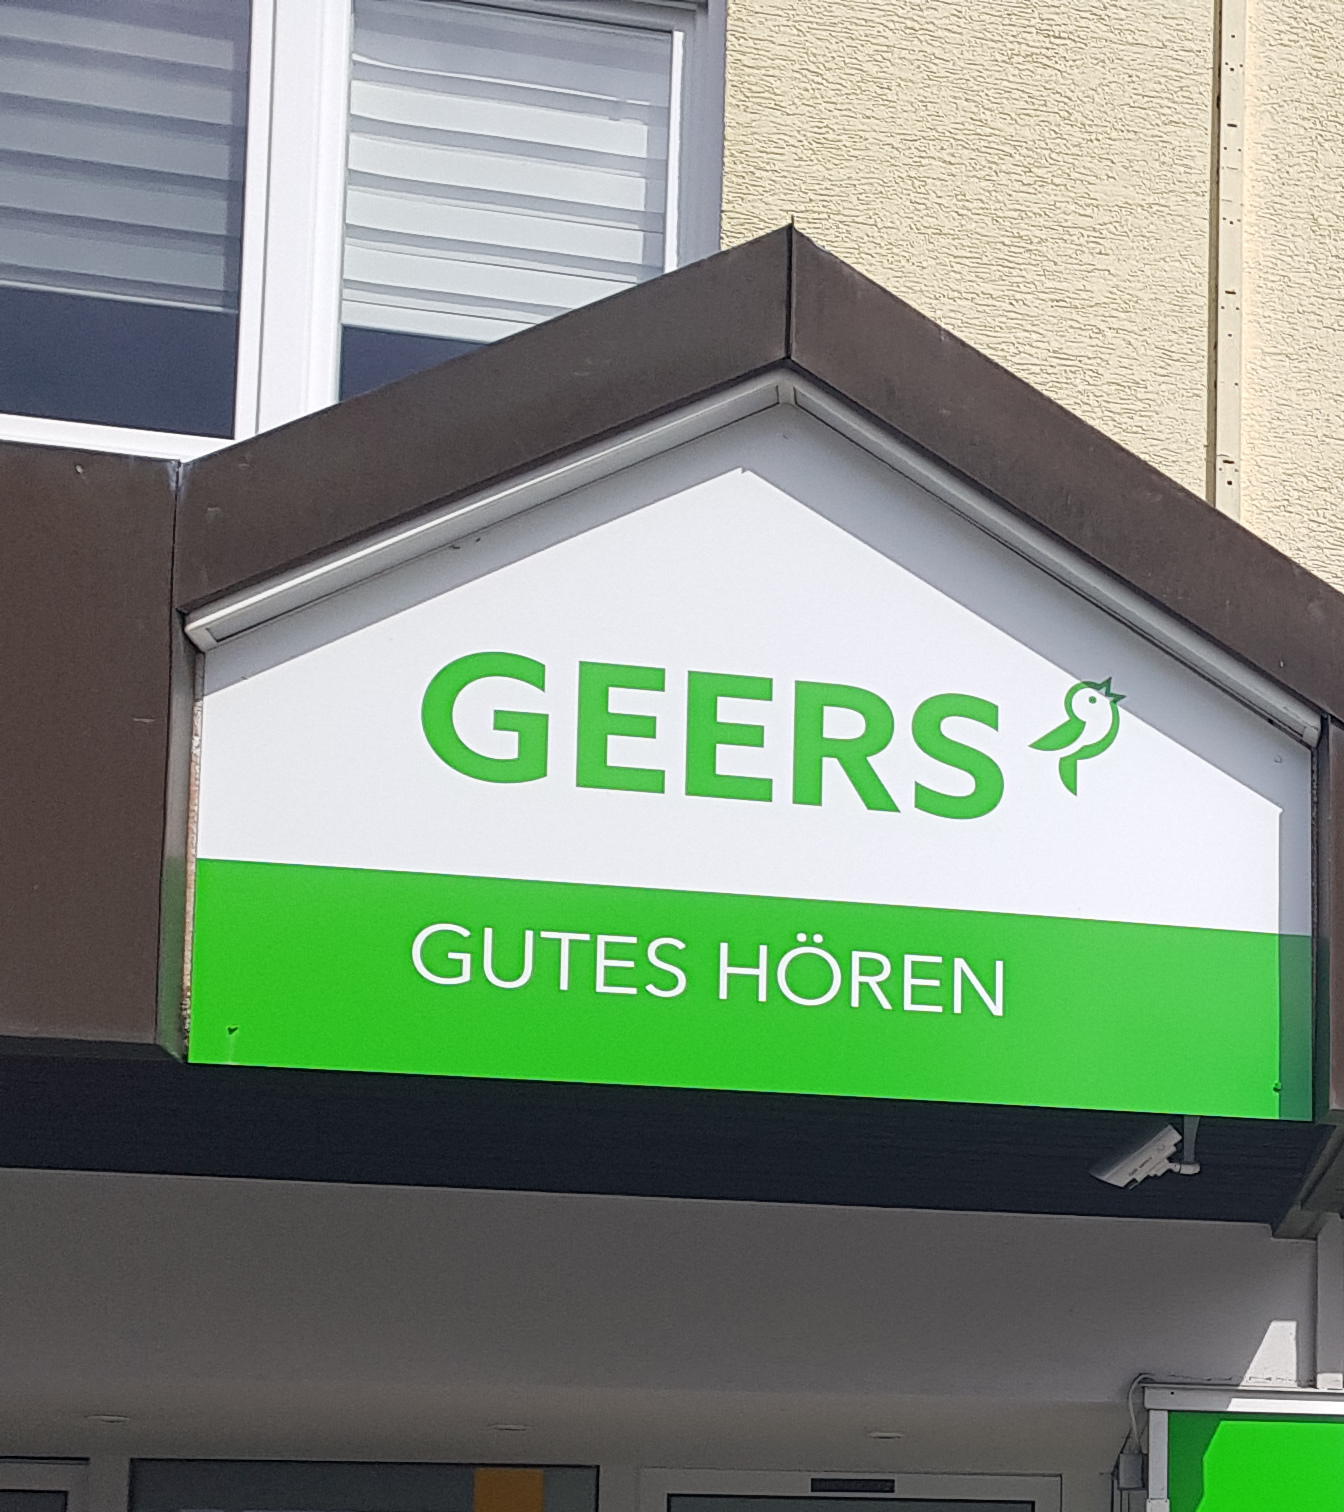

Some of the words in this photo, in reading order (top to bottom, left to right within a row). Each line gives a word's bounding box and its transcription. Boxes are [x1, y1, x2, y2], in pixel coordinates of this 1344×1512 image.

[421, 651, 1005, 820] GEERS
[411, 923, 687, 999] GUTES
[717, 932, 1005, 1018] HÖREN
